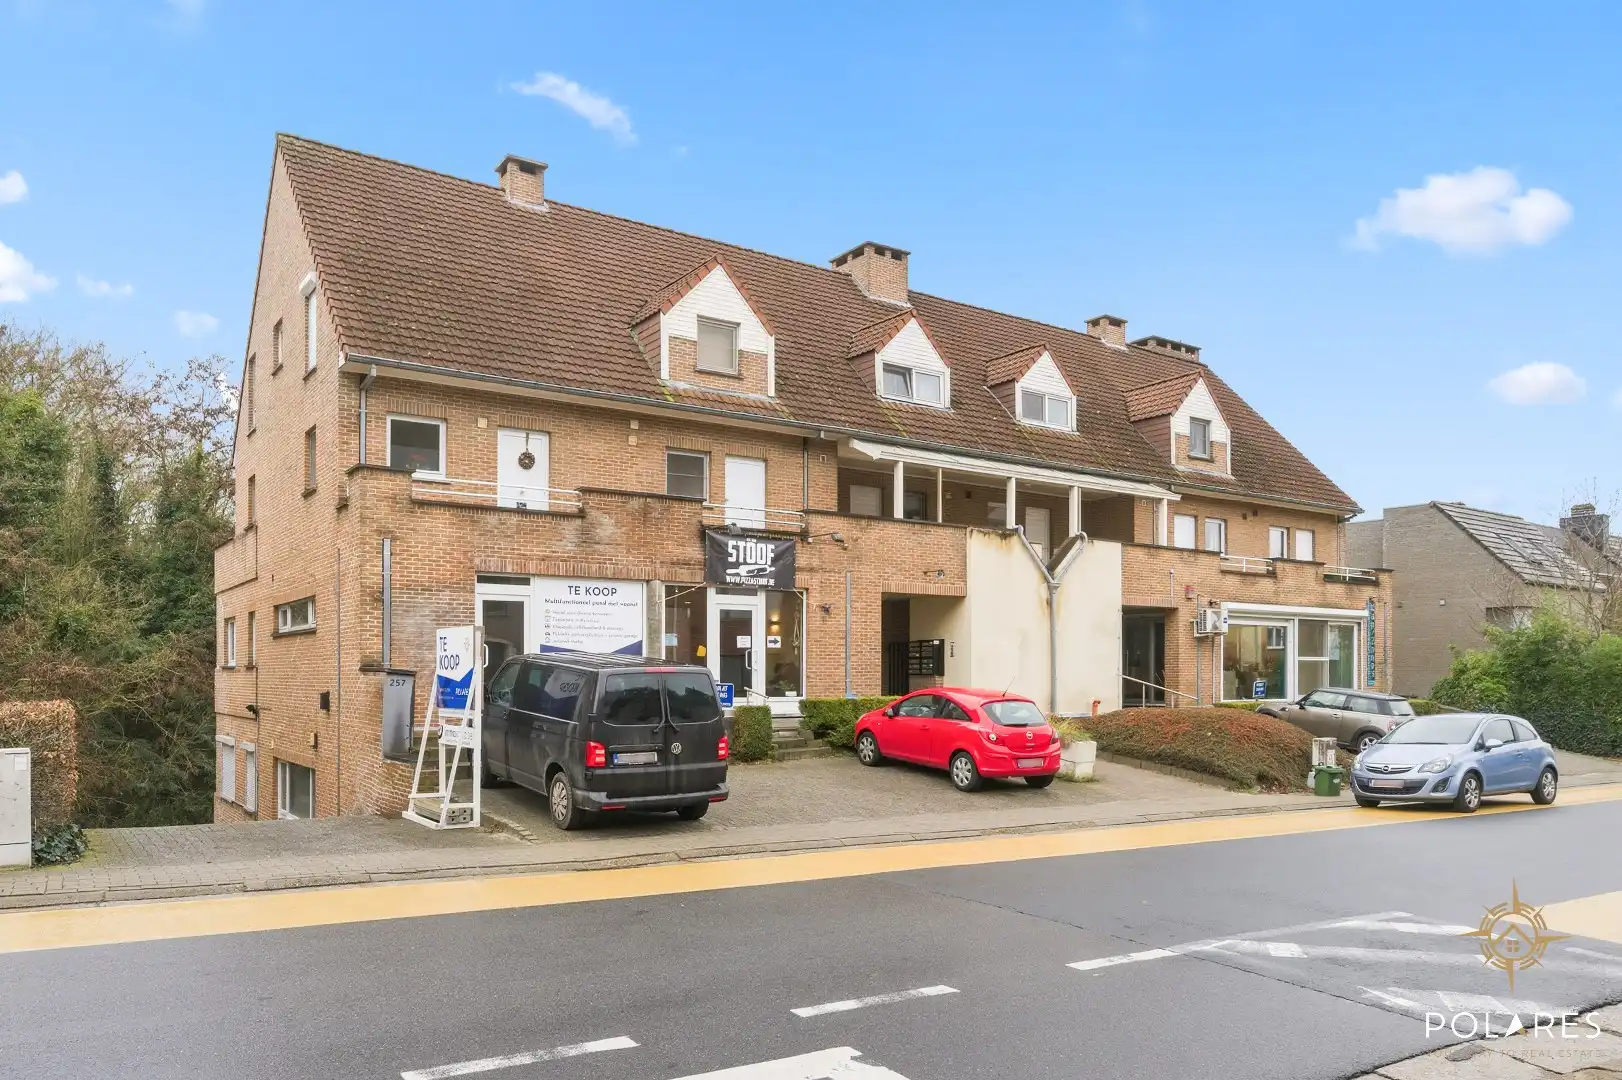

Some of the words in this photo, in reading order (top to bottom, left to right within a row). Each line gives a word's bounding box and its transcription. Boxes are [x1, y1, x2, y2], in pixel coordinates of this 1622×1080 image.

[568, 586, 581, 595] TE
[585, 587, 617, 596] KOOP
[440, 637, 447, 651] TE
[440, 655, 460, 670] KOOP
[390, 679, 406, 687] 257
